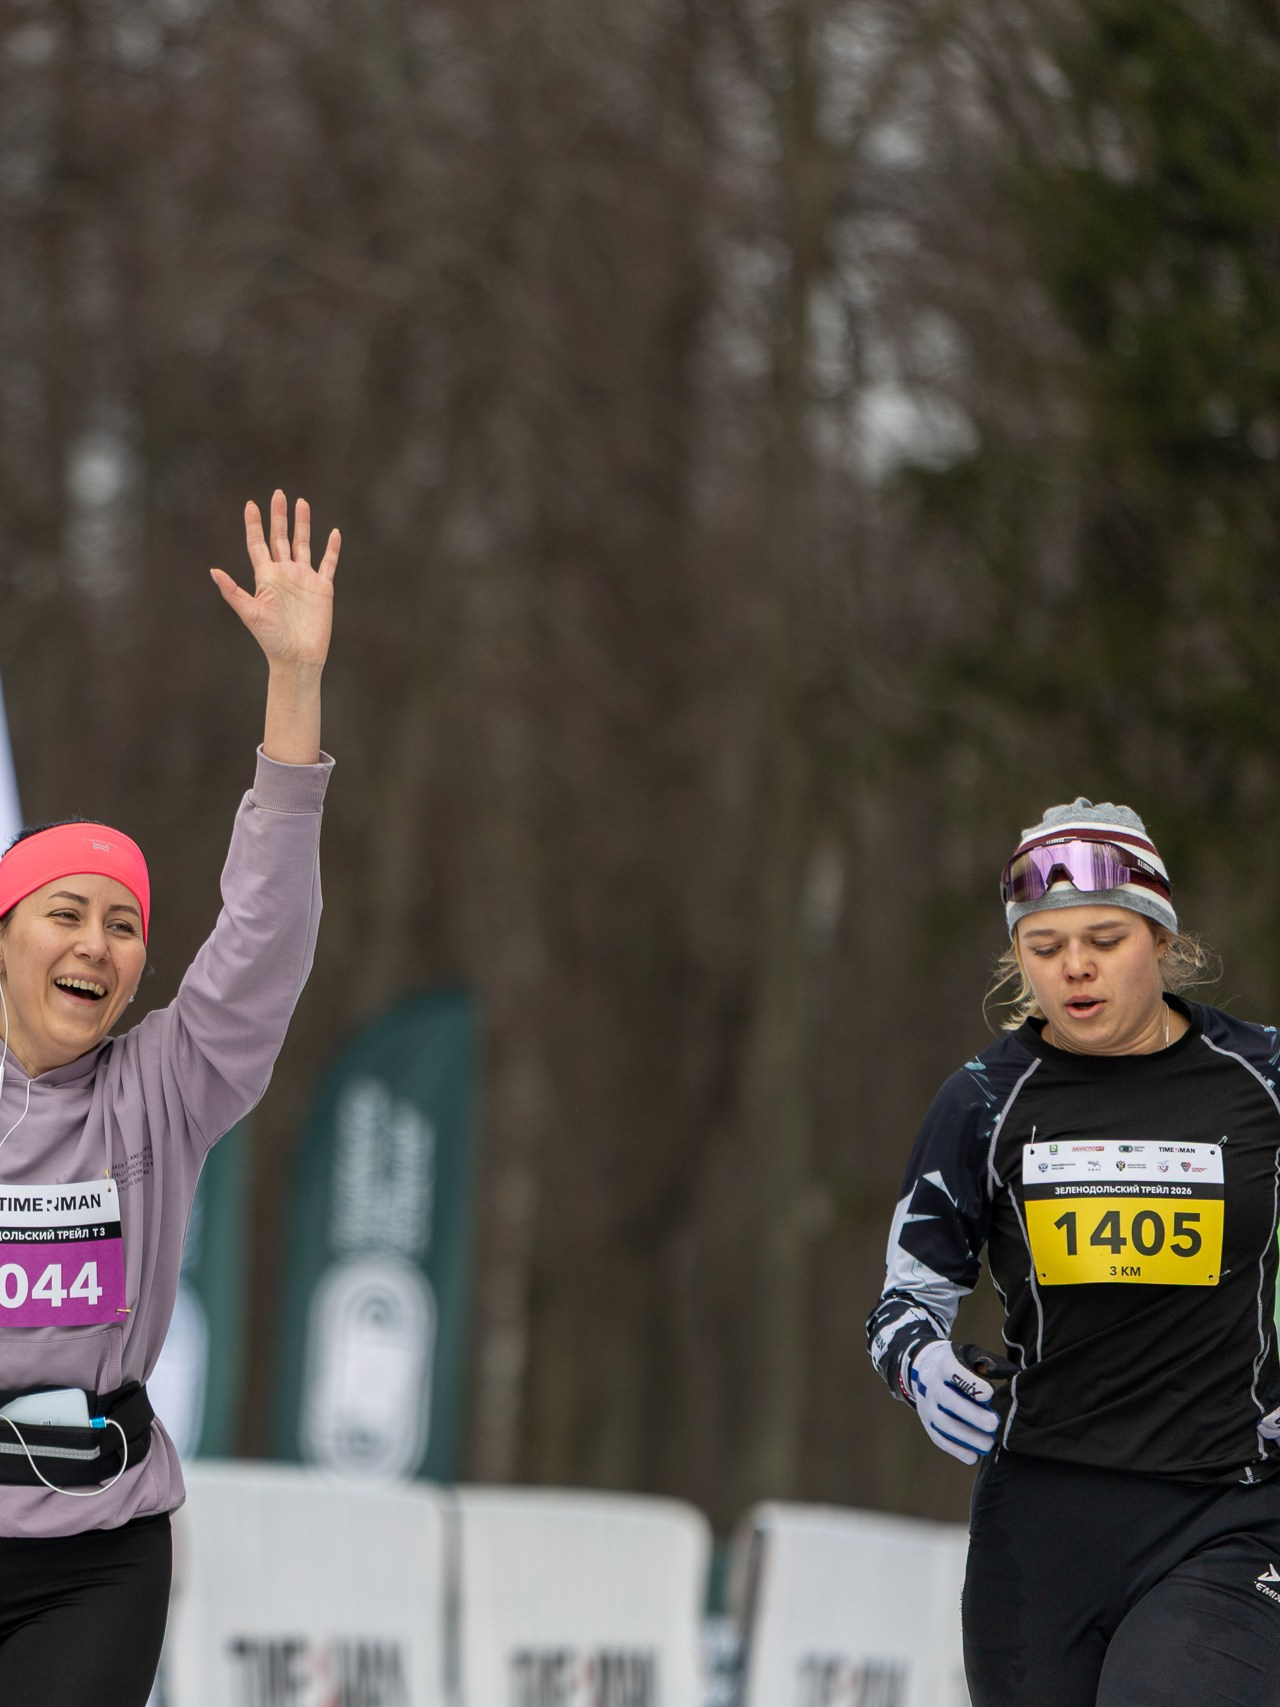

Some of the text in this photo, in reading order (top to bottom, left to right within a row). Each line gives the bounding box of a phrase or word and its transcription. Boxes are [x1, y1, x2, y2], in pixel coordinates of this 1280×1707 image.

[1055, 1185, 1192, 1195] ЗЕЛЕНОДОЛЬСКИЙ ТРЕЙЛ 2026
[56, 1228, 89, 1240] ТРЕЙЛ
[1054, 1210, 1202, 1258] 1405
[1109, 1266, 1141, 1276] 3 КМ
